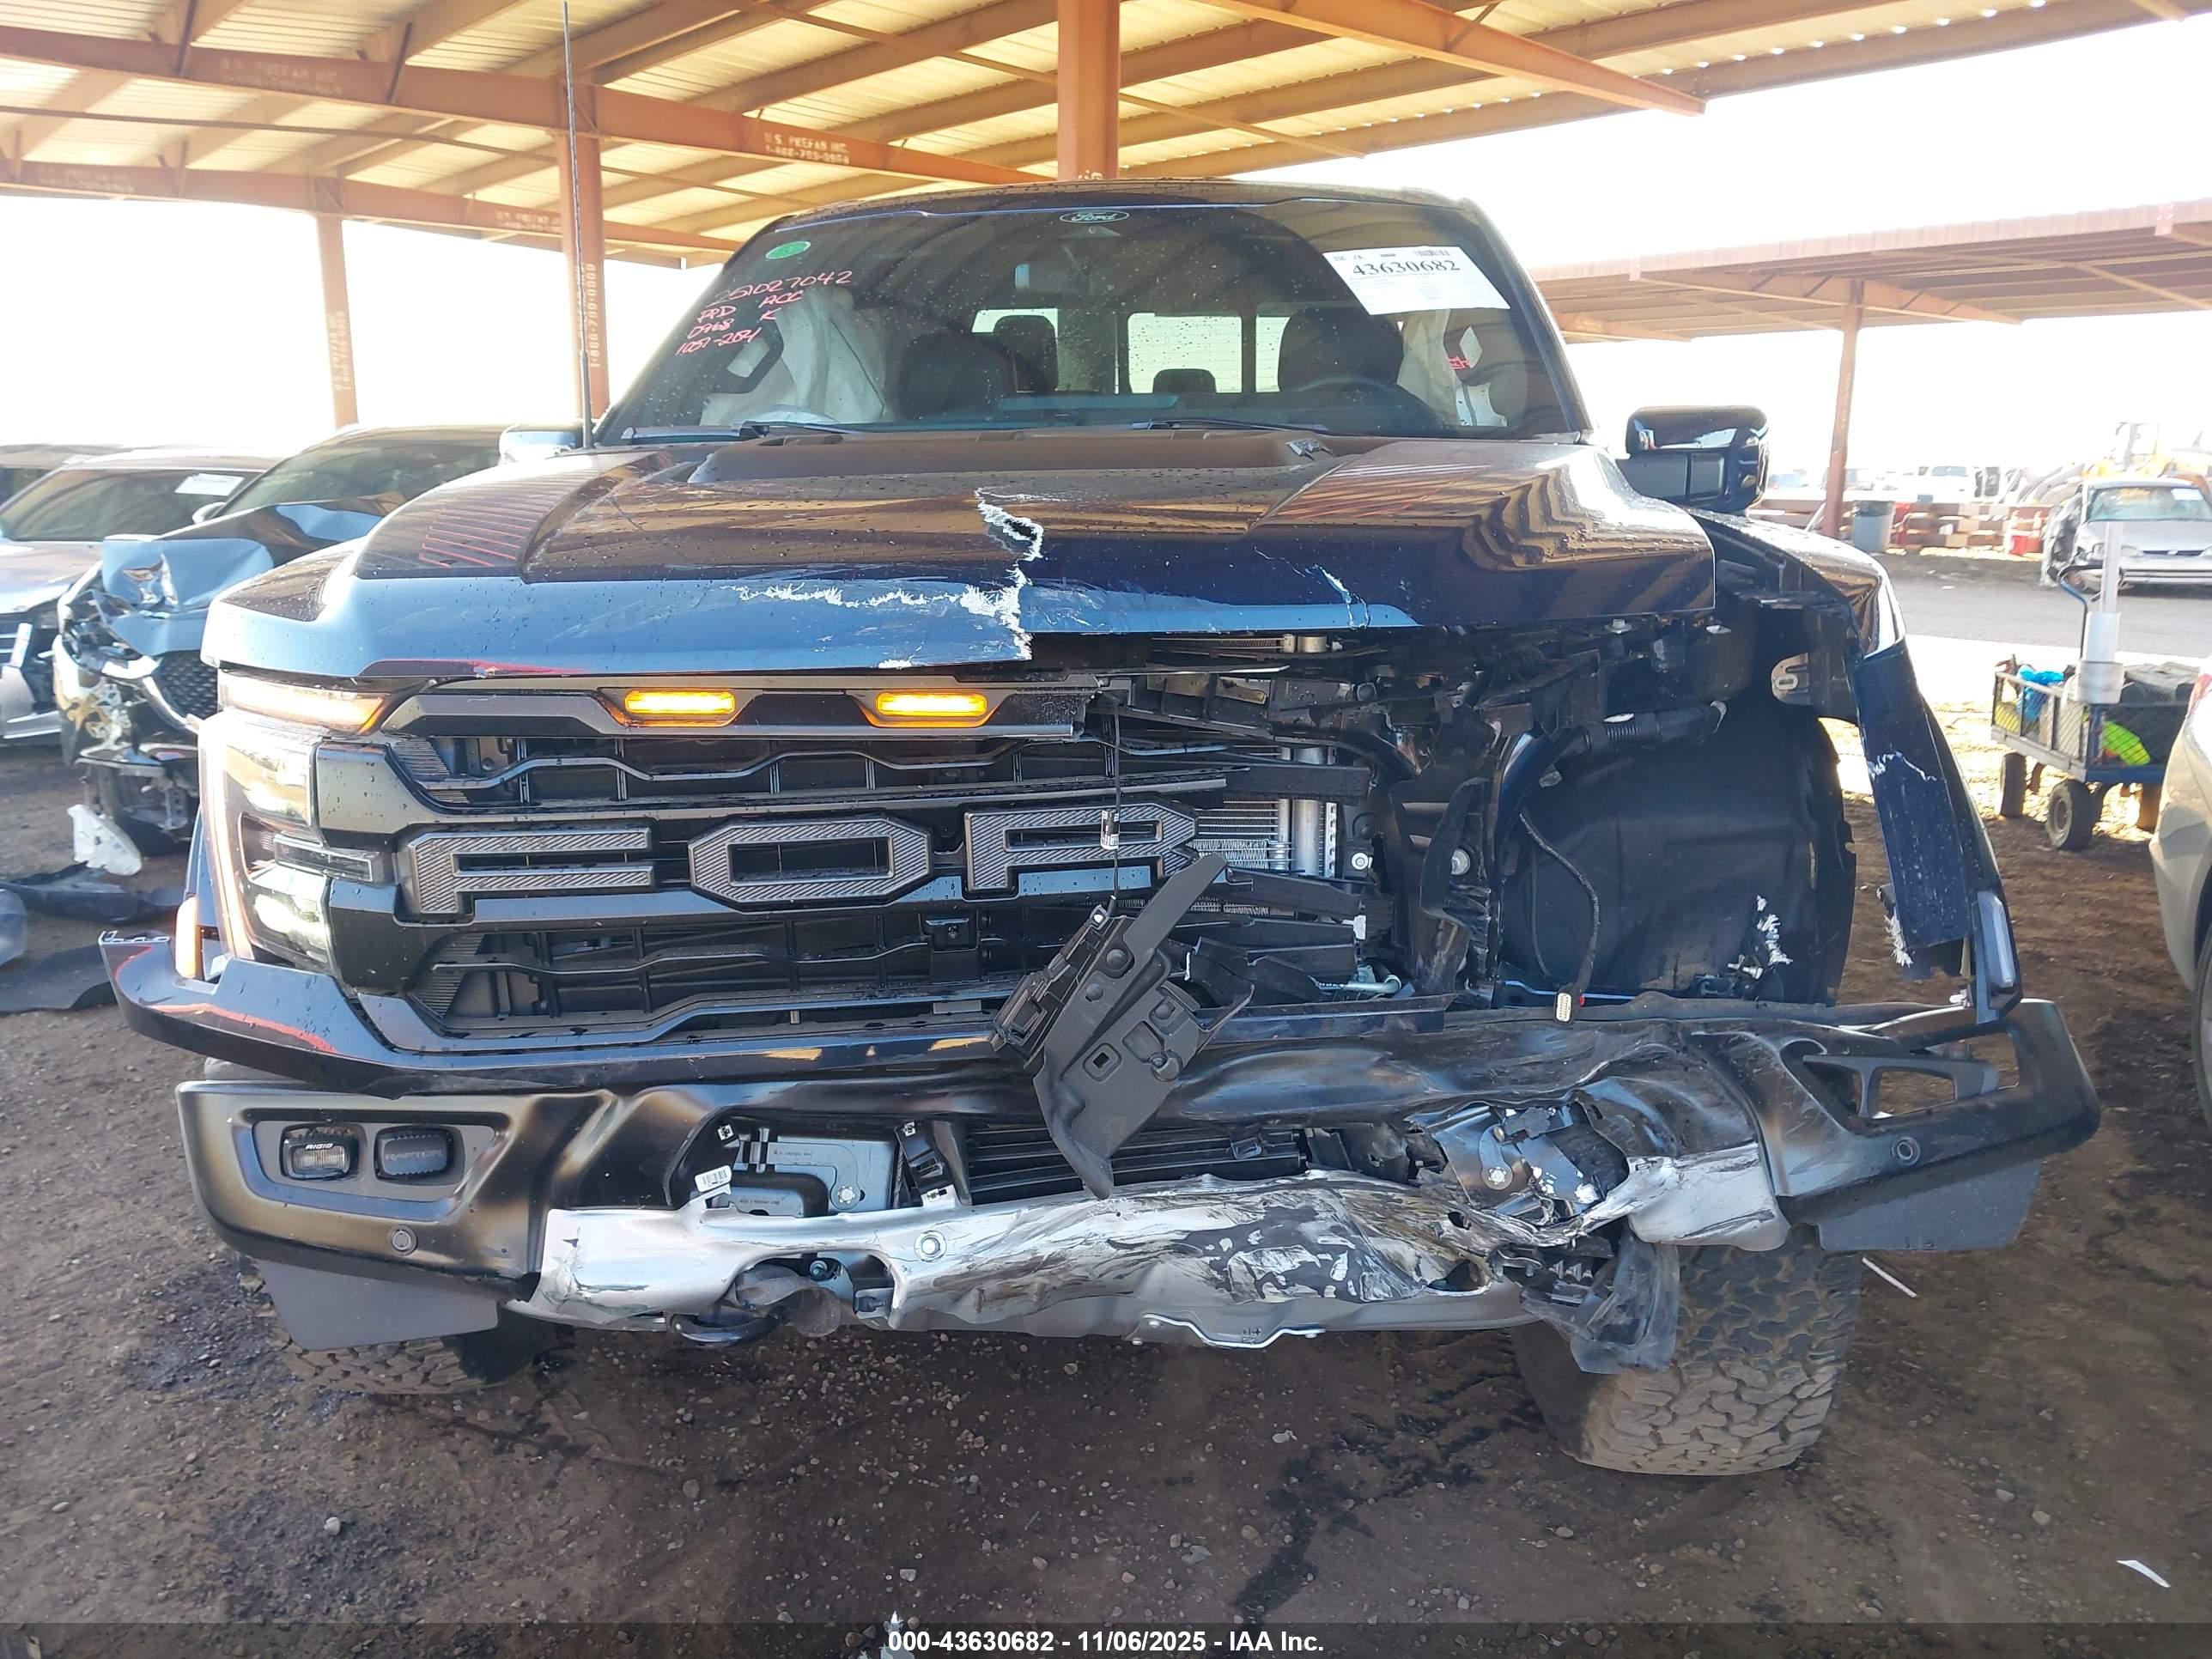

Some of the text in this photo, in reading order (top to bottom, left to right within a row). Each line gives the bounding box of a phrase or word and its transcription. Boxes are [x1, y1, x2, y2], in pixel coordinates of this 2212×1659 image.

[1070, 211, 1119, 222] Ford
[1352, 259, 1462, 276] 43630682
[305, 1142, 334, 1151] RIGID
[386, 1149, 443, 1162] RAPTOR
